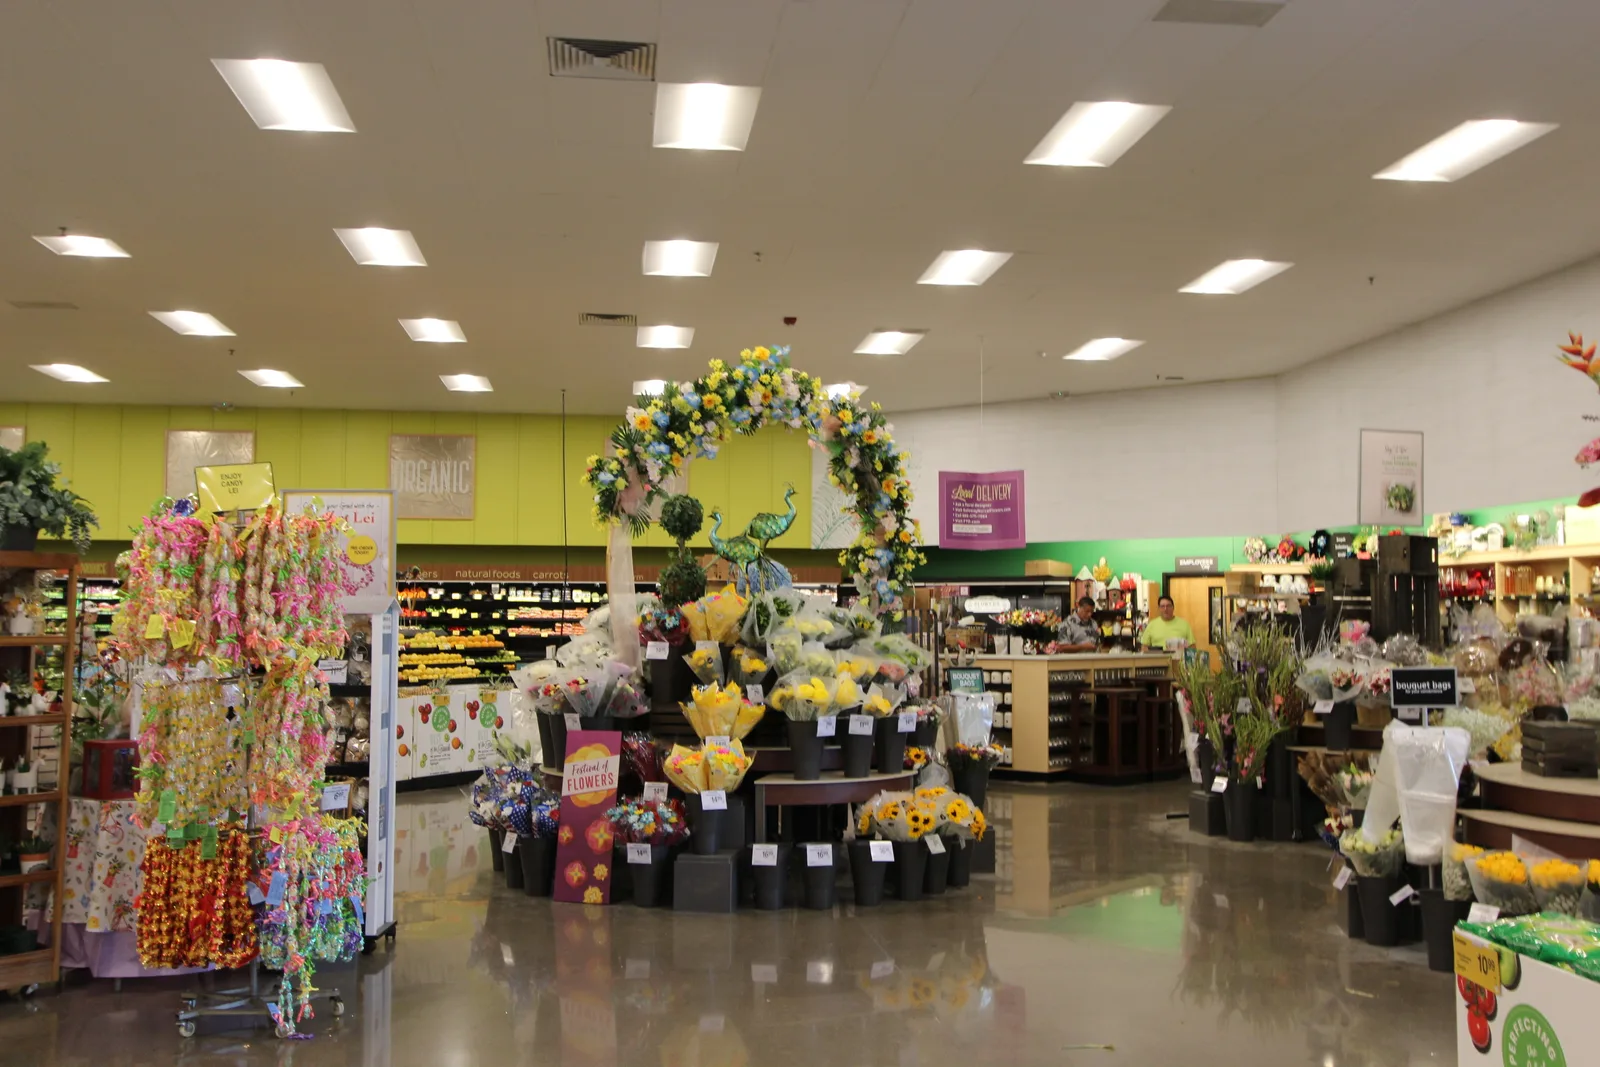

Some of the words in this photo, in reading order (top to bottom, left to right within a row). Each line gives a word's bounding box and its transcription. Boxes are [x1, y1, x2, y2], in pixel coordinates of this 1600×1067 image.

[391, 460, 470, 494] ORGANIC
[221, 480, 243, 488] CANDY
[951, 484, 975, 502] Local
[977, 483, 1011, 501] DELIVERY
[353, 511, 375, 523] Lei
[455, 569, 491, 579] natural
[492, 569, 521, 579] foods
[532, 570, 569, 580] carrots
[952, 672, 980, 680] BOUQUET
[1395, 680, 1430, 690] bouquet
[1432, 680, 1451, 691] bags
[572, 762, 599, 776] Festival
[602, 759, 609, 773] of
[567, 772, 614, 791] FLOWERS
[1508, 1016, 1556, 1066] PERFECTING
